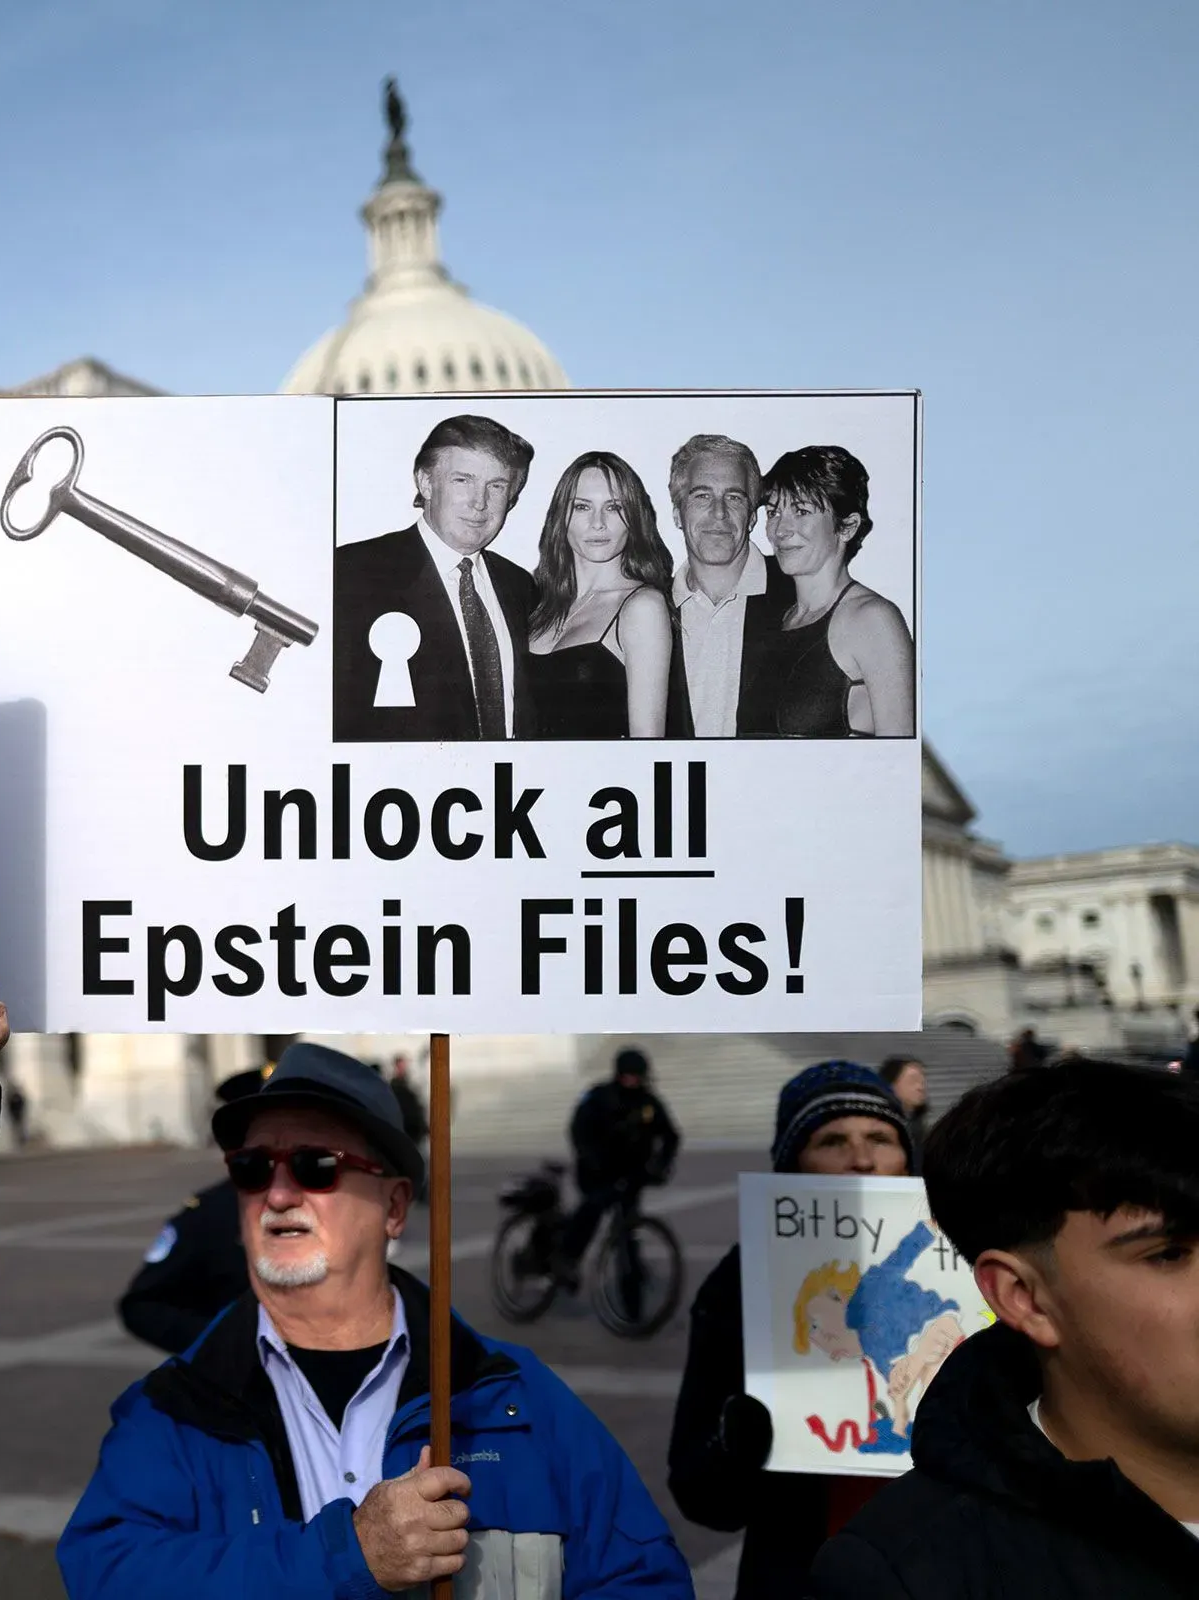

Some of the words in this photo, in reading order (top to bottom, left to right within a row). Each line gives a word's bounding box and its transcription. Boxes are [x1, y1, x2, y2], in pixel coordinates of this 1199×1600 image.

[182, 762, 547, 862] Unlock
[584, 761, 708, 861] all
[82, 899, 472, 1022] Epstein
[521, 897, 806, 996] Files!
[775, 1196, 825, 1239] Bit
[834, 1200, 884, 1254] by
